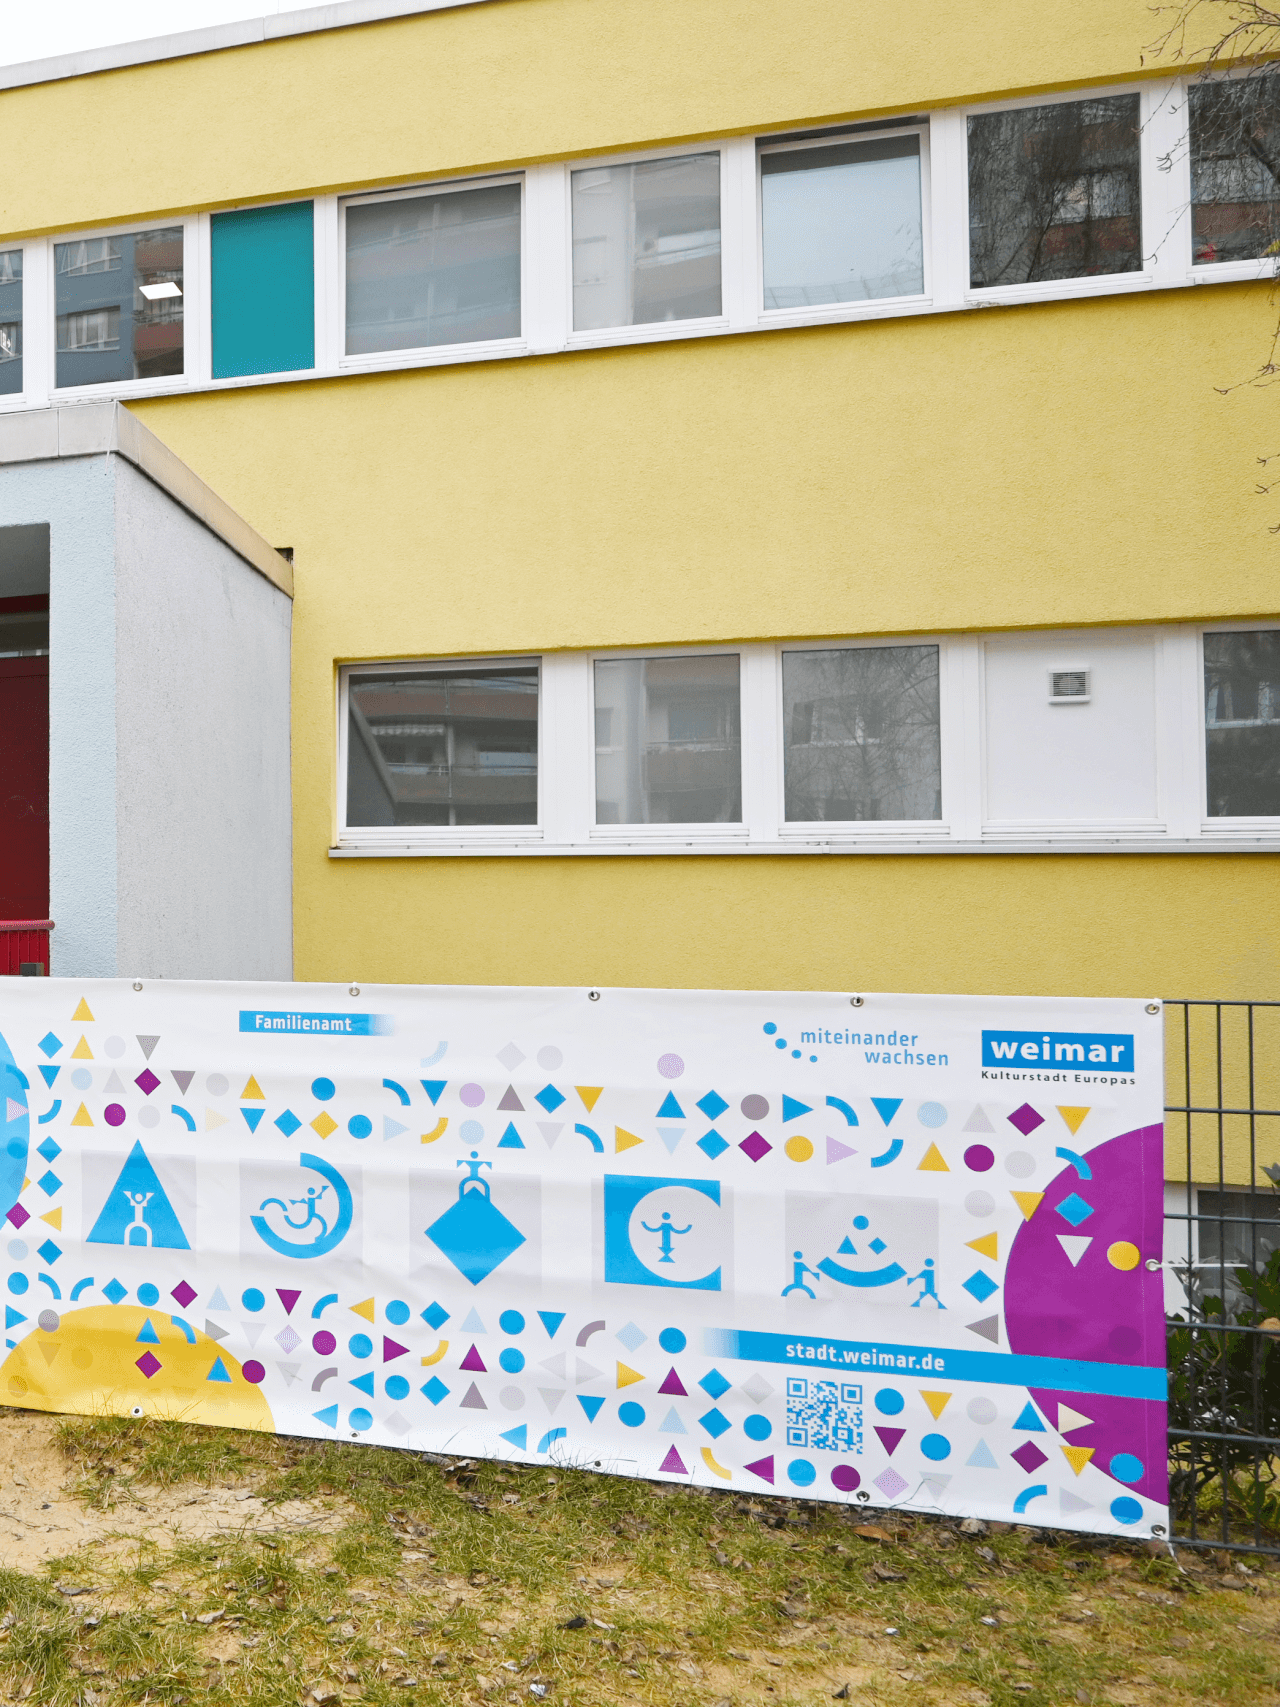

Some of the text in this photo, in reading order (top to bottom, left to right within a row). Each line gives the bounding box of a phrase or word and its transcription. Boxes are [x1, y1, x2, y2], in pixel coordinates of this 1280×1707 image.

[255, 1014, 353, 1032] Familienamt
[800, 1028, 919, 1047] miteinander
[864, 1048, 949, 1067] wachsen
[990, 1035, 1125, 1064] weimar
[981, 1070, 1137, 1087] Kulturstadt Europas
[785, 1342, 946, 1372] stadt.weimar.de
